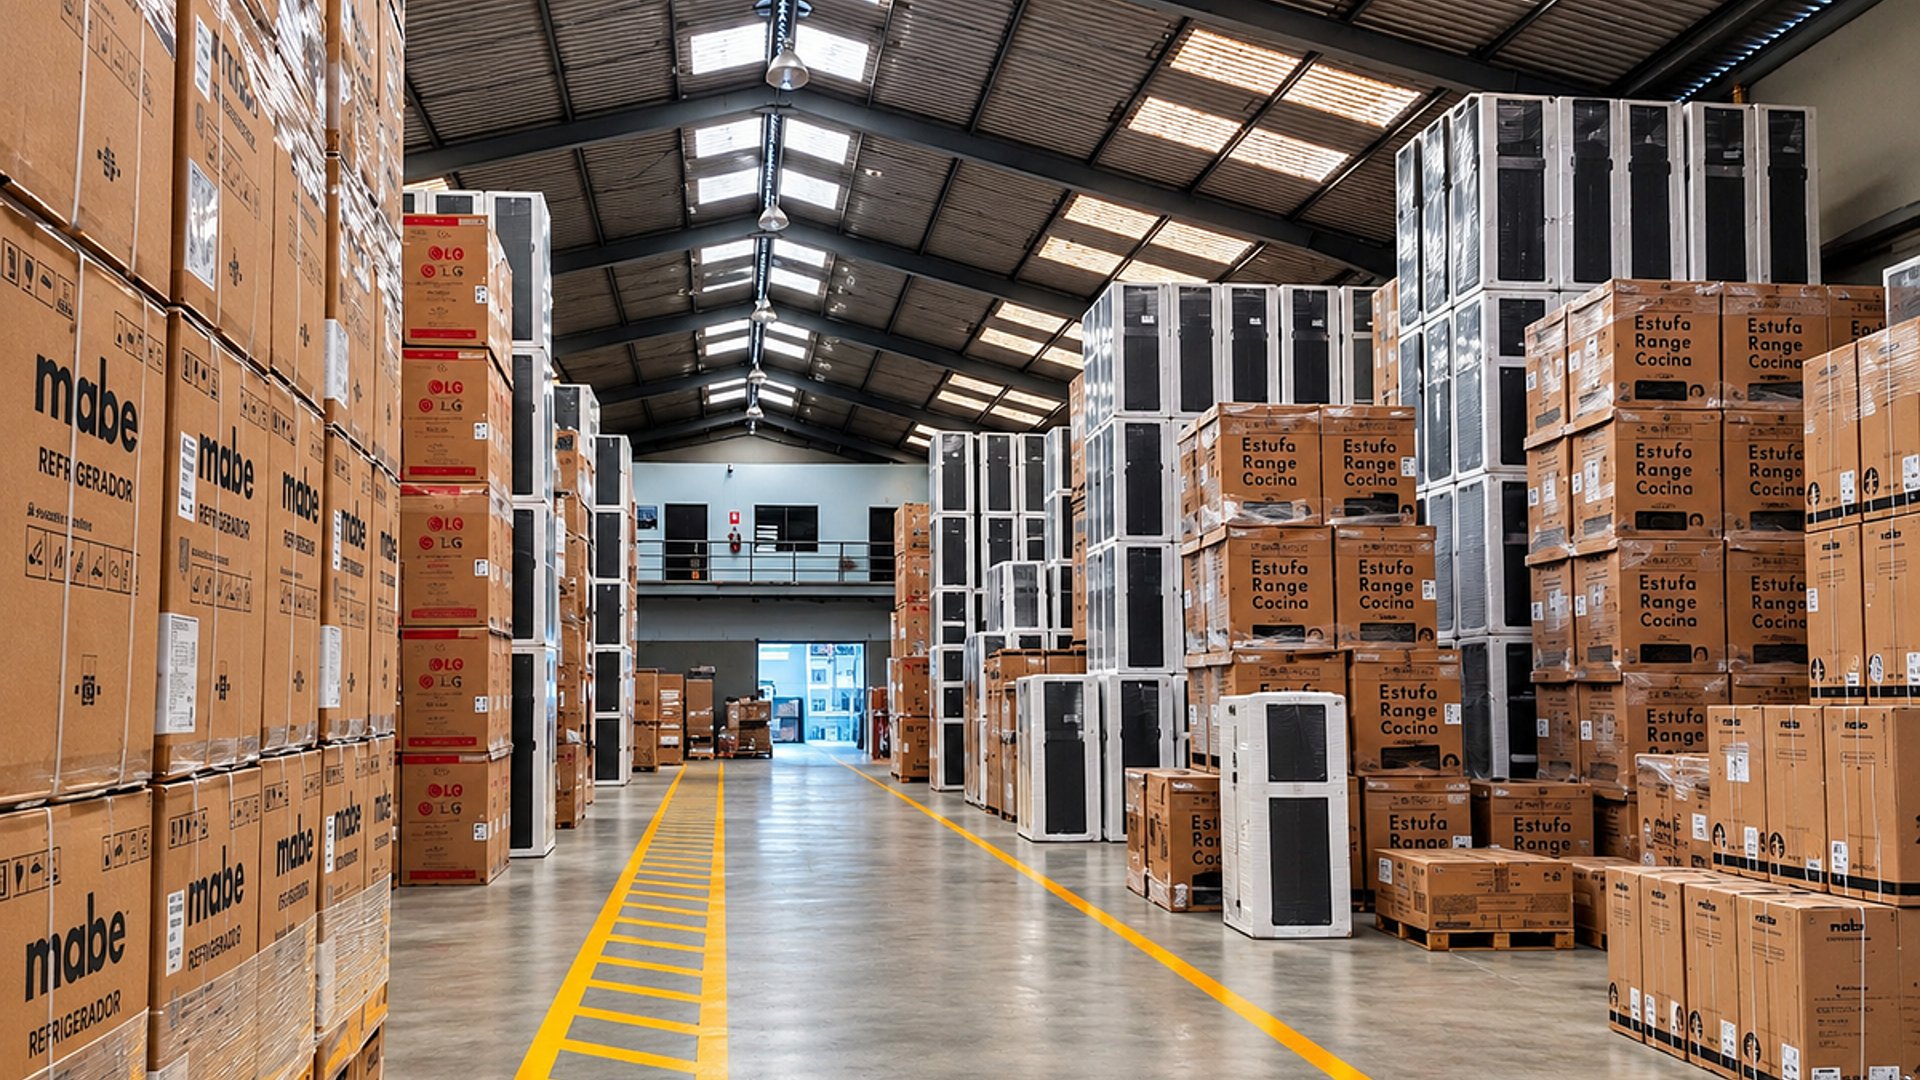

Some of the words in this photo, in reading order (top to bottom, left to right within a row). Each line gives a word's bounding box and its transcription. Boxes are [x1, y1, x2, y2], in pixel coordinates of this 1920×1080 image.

[444, 247, 464, 261] LG
[442, 265, 464, 277] LG
[1635, 315, 1690, 330] Estufa
[1636, 333, 1691, 351] Range
[1636, 351, 1691, 366] Cocina
[444, 381, 464, 394] LG
[35, 354, 138, 453] mabe
[440, 399, 464, 412] LG
[1243, 437, 1295, 452] Estufa
[198, 425, 254, 500] mabe
[1243, 455, 1296, 473] Range
[1344, 455, 1396, 473] Range
[39, 446, 133, 502] REFRGERADOR
[1637, 462, 1692, 479] Range
[1243, 472, 1296, 486] Cocina
[282, 466, 319, 524] mabe
[1637, 480, 1692, 495] Cocina
[199, 503, 250, 540] REFRGERADOR
[444, 517, 464, 531] LG
[440, 537, 463, 549] LG
[1252, 560, 1308, 575] Estufa
[1359, 560, 1413, 575] Estufa
[1253, 578, 1308, 596] Range
[1360, 577, 1413, 596] Range
[1640, 574, 1696, 590] Estufa
[1253, 596, 1308, 609] Cocina
[1360, 596, 1413, 609] Cocina
[1641, 594, 1696, 611] Range
[1641, 613, 1696, 627] Cocina
[443, 658, 464, 671] LG
[440, 675, 463, 688] LG
[1380, 683, 1437, 699] Estufa
[1381, 702, 1437, 720] Range
[1647, 708, 1703, 724] Estufa
[1381, 720, 1438, 734] Cocina
[1648, 727, 1704, 745] Range
[443, 784, 463, 797] LG
[439, 802, 462, 815] LG
[1192, 815, 1217, 830] Est
[1390, 813, 1447, 830] Estufa
[276, 813, 313, 877] mabe
[1192, 850, 1222, 865] Coc
[188, 845, 245, 927] mabe
[25, 891, 126, 1002] mabe
[28, 989, 121, 1059] REFRIGERADOR
